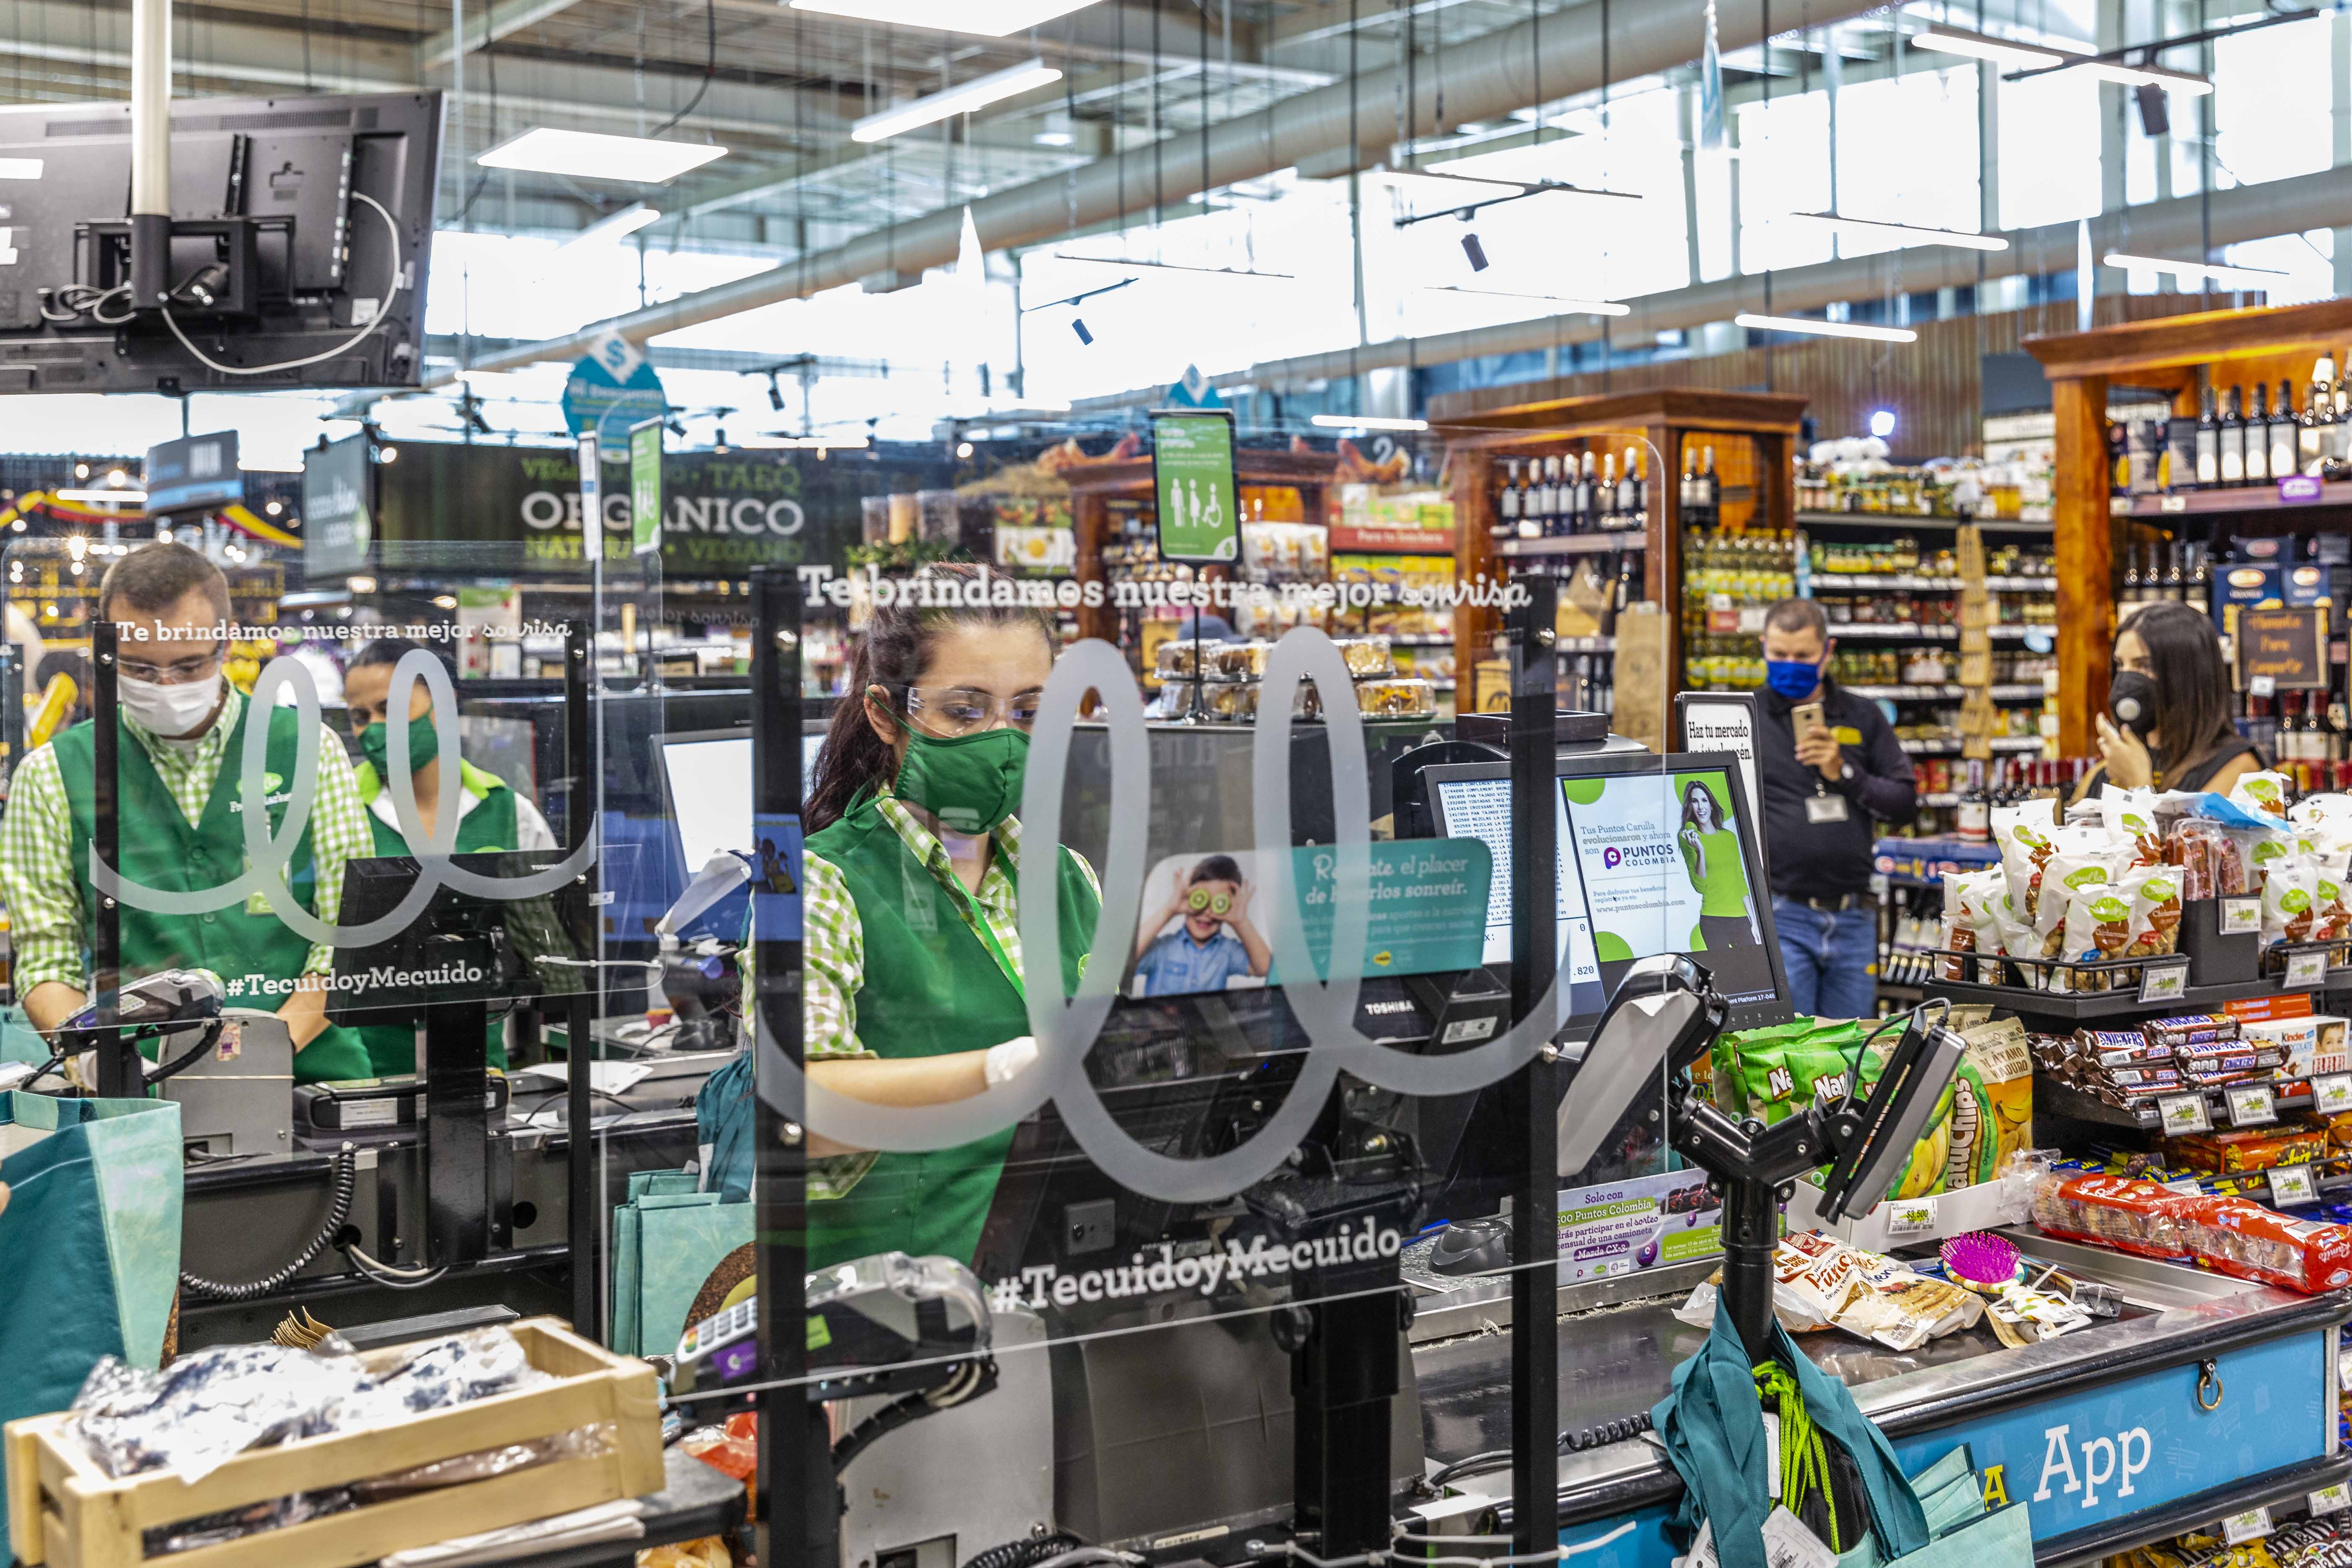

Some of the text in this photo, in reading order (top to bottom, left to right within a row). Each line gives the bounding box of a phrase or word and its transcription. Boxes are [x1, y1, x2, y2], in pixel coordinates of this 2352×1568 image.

[797, 563, 1533, 615] Te brindamos nuestra mejor sonrisa
[116, 619, 573, 643] Te brindamos nuestra mejor sonrisa
[1689, 719, 1748, 738] Haz tu mercado
[1580, 821, 1656, 835] Tus Puntos Carulla
[1583, 834, 1641, 845] evolucionaron
[1649, 831, 1671, 839] ahora
[1623, 844, 1673, 858] PUNTOS
[1400, 854, 1468, 879] el placer
[1625, 856, 1676, 867] COLOMBIA
[1305, 878, 1468, 905] de sonreír.
[1596, 900, 1685, 913] www.puntoscolombia.com
[227, 960, 482, 997] #TecuidoyMecuido
[1365, 1000, 1415, 1015] TOSHIBA
[2165, 1015, 2210, 1027] SNICKERS
[2098, 1032, 2145, 1047] SNICKERS
[1982, 1119, 1994, 1167] Orgullosamente
[1585, 1191, 1623, 1204] Solo con
[1575, 1210, 1607, 1221] Puntos
[1609, 1200, 1651, 1215] Colombia
[1575, 1224, 1613, 1239] participar
[1626, 1218, 1633, 1227] el
[1634, 1214, 1659, 1226] sorteo
[1587, 1236, 1596, 1244] de
[1614, 1227, 1653, 1239] camioneta
[1578, 1247, 1604, 1259] Mazda
[1782, 1253, 1800, 1264] haz
[993, 1216, 1400, 1313] #TecuidoyMecuido
[1791, 1258, 1809, 1268] oros
[2033, 1424, 2151, 1508] App
